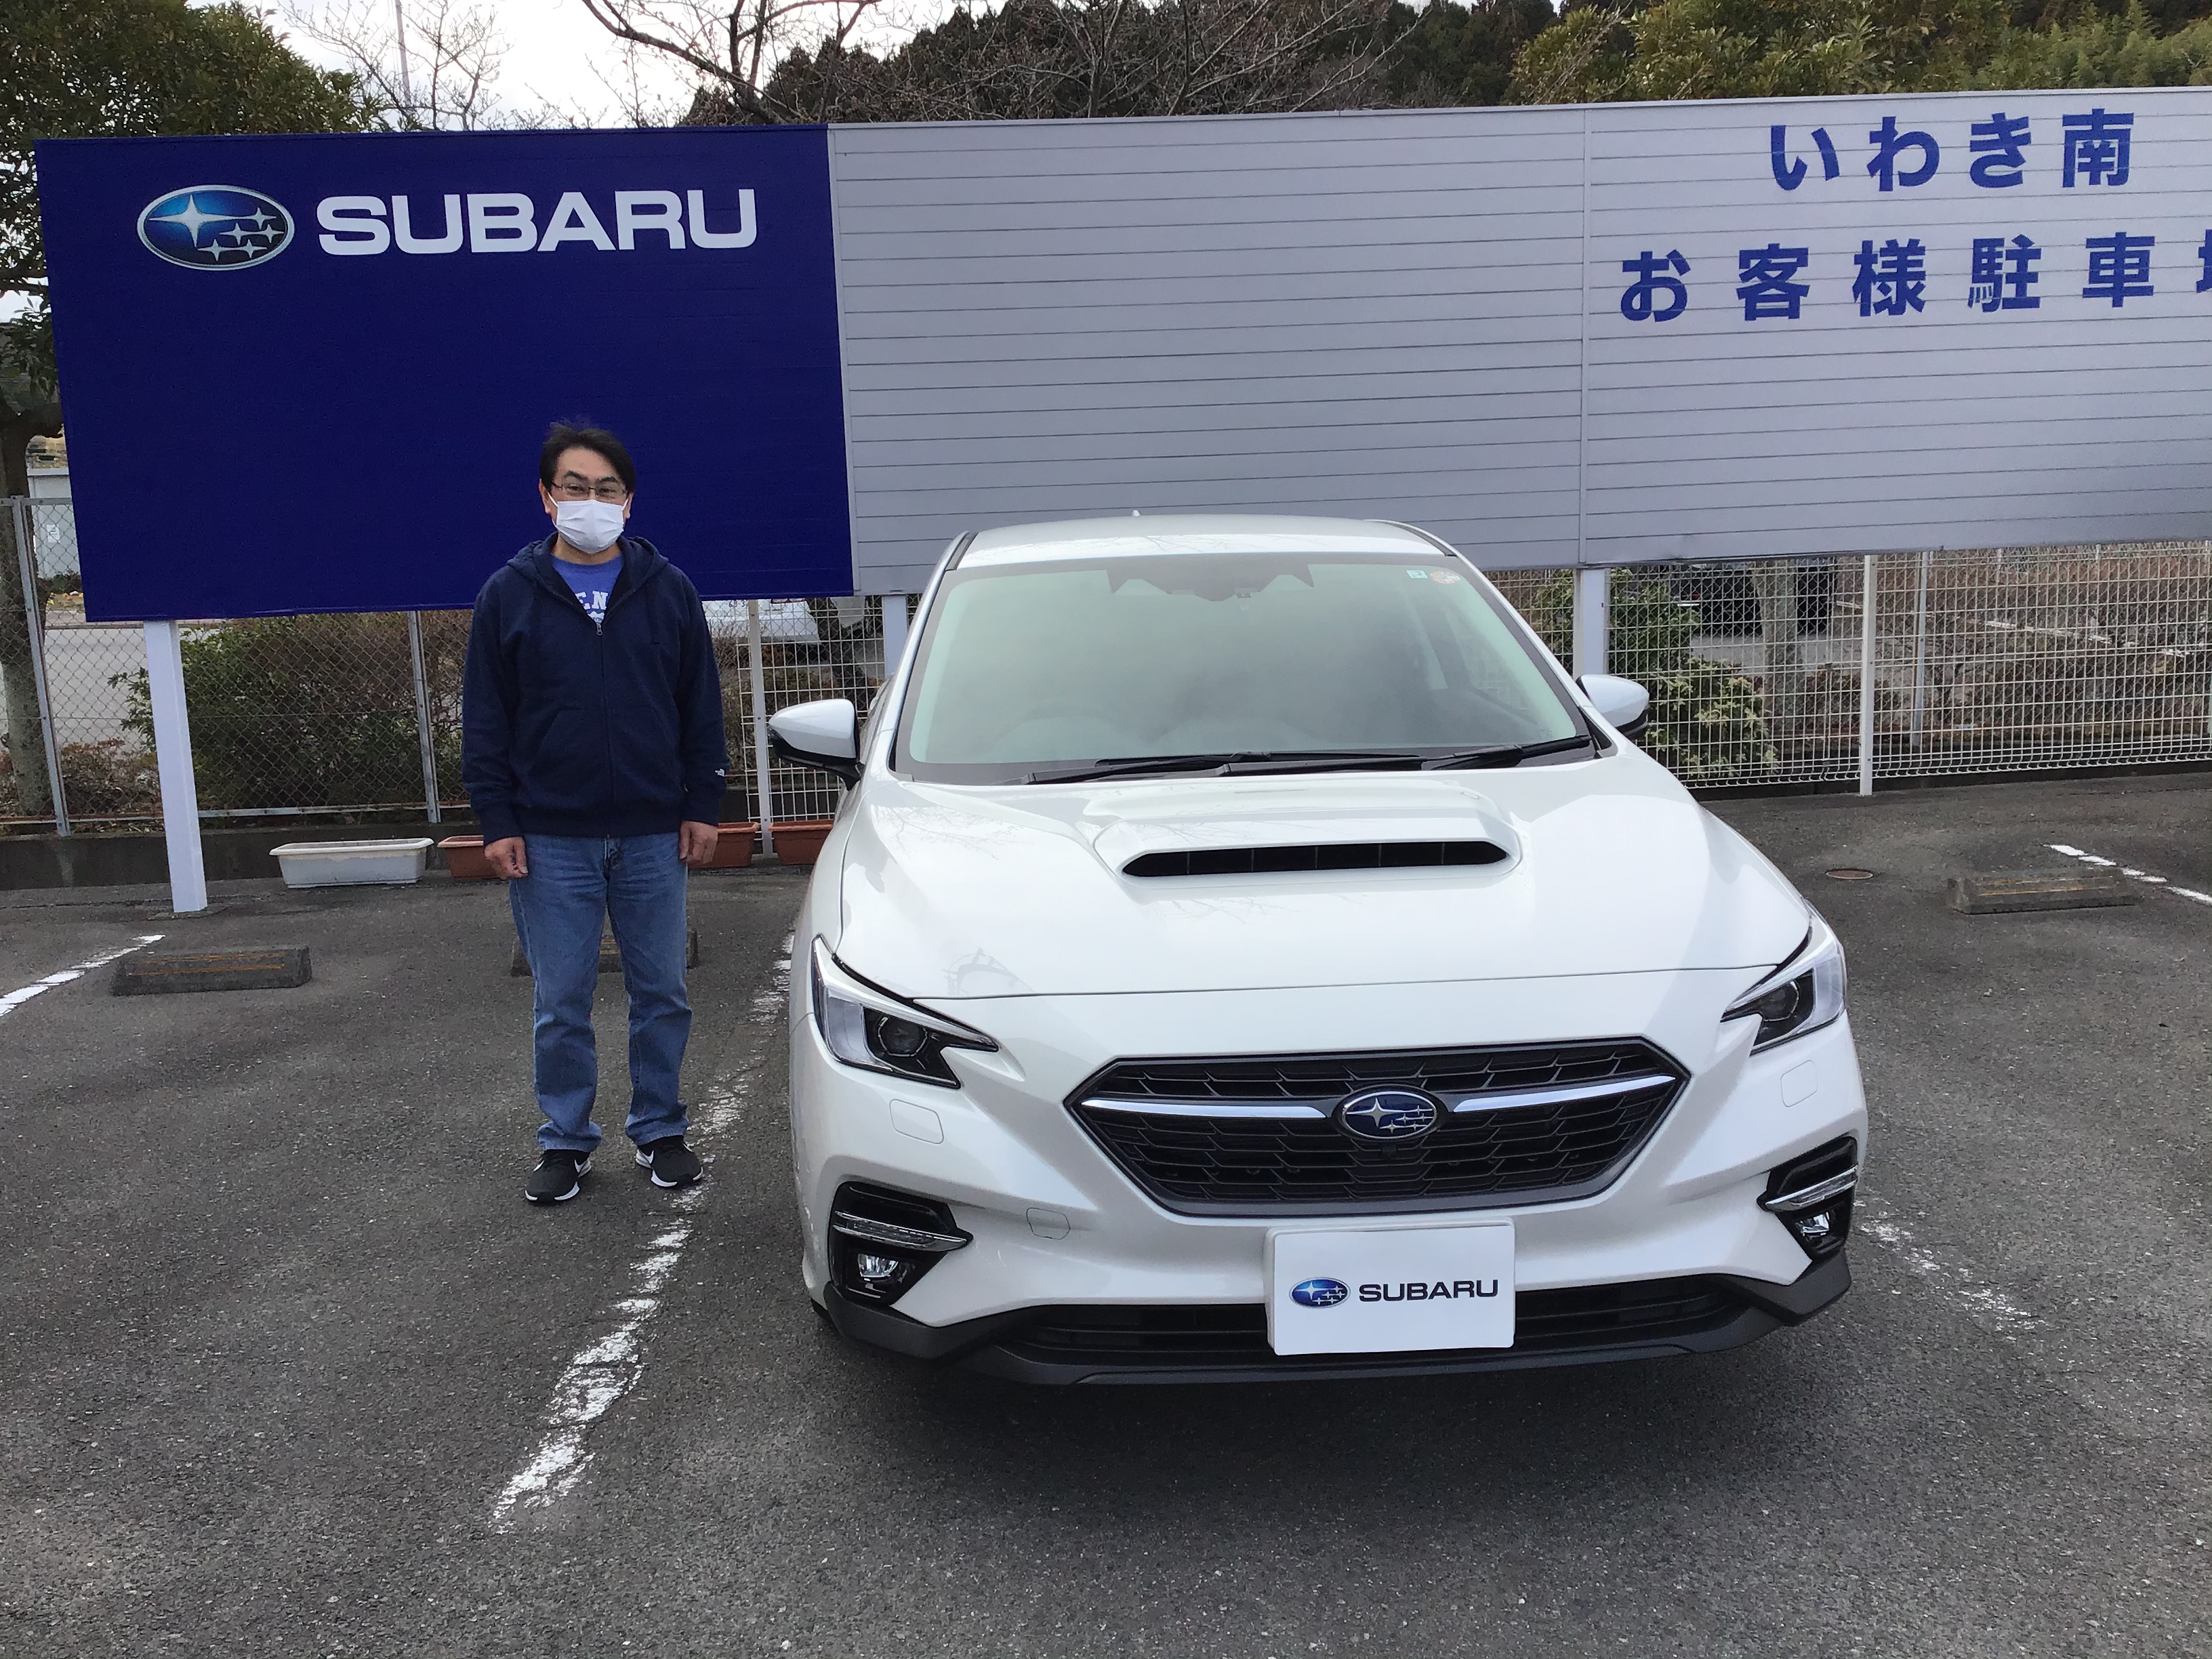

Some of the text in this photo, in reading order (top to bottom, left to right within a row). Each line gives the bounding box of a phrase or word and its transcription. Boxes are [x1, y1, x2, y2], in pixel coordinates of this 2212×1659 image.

[1770, 108, 2134, 192] いわき南
[316, 188, 758, 255] SUBARU
[1359, 1279, 1499, 1303] SUBARU
